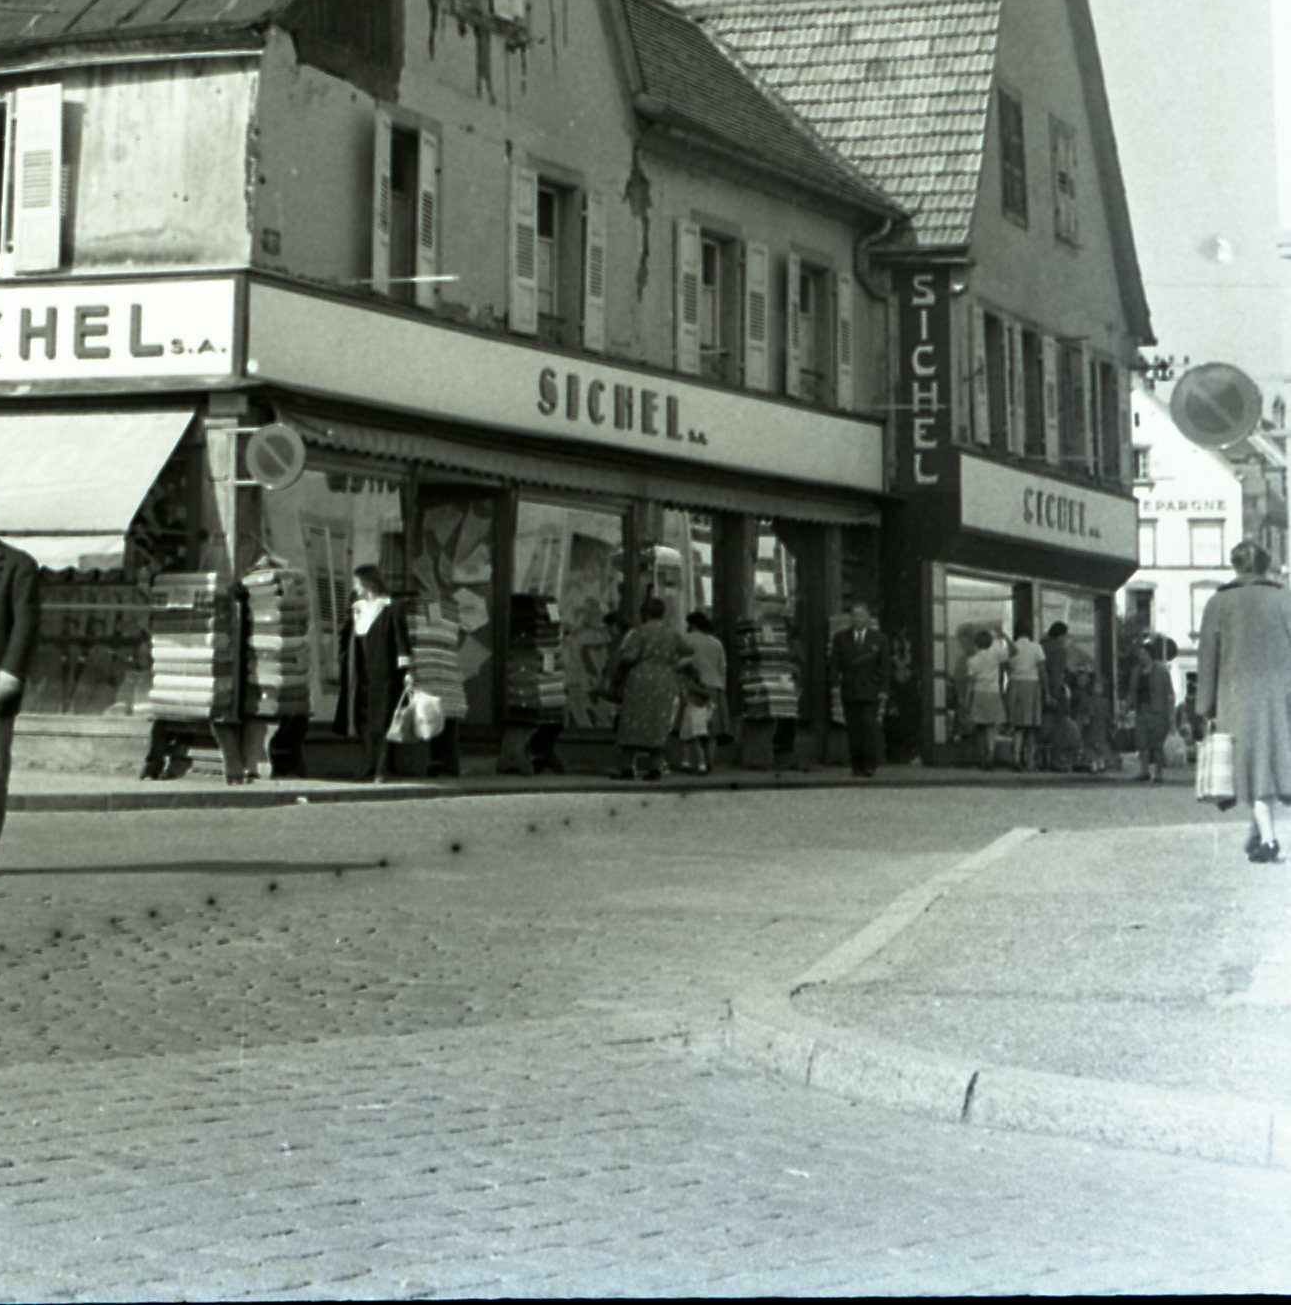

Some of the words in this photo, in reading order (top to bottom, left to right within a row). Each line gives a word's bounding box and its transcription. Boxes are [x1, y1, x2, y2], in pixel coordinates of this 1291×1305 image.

[170, 338, 227, 355] S.A.
[911, 272, 939, 485] SICHEL
[537, 366, 683, 442] SICHEL
